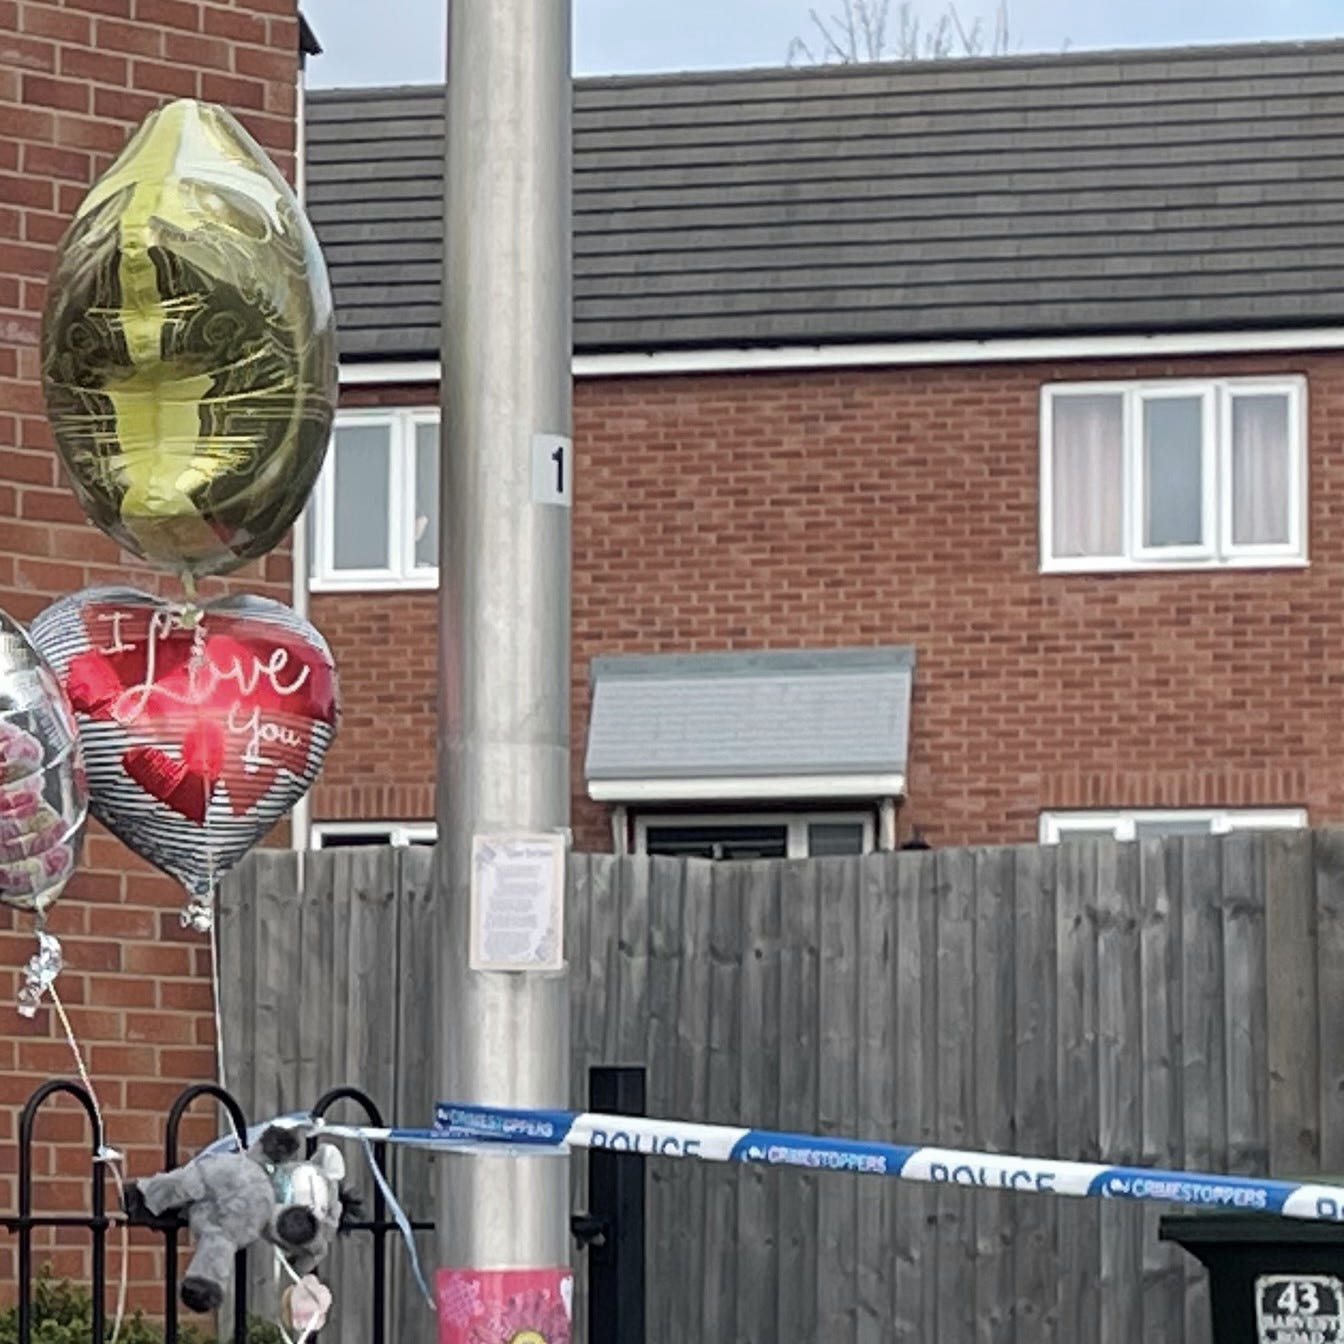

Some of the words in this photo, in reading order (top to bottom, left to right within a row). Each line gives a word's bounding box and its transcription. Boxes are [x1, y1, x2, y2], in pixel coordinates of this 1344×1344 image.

[551, 446, 564, 494] 1
[97, 611, 136, 655] I
[111, 609, 311, 726] Love
[227, 699, 301, 758] You
[767, 1145, 887, 1174] CRIMESTOPPERS
[1132, 1178, 1267, 1209] CRIMESTOPPERS
[1277, 1282, 1319, 1315] 43
